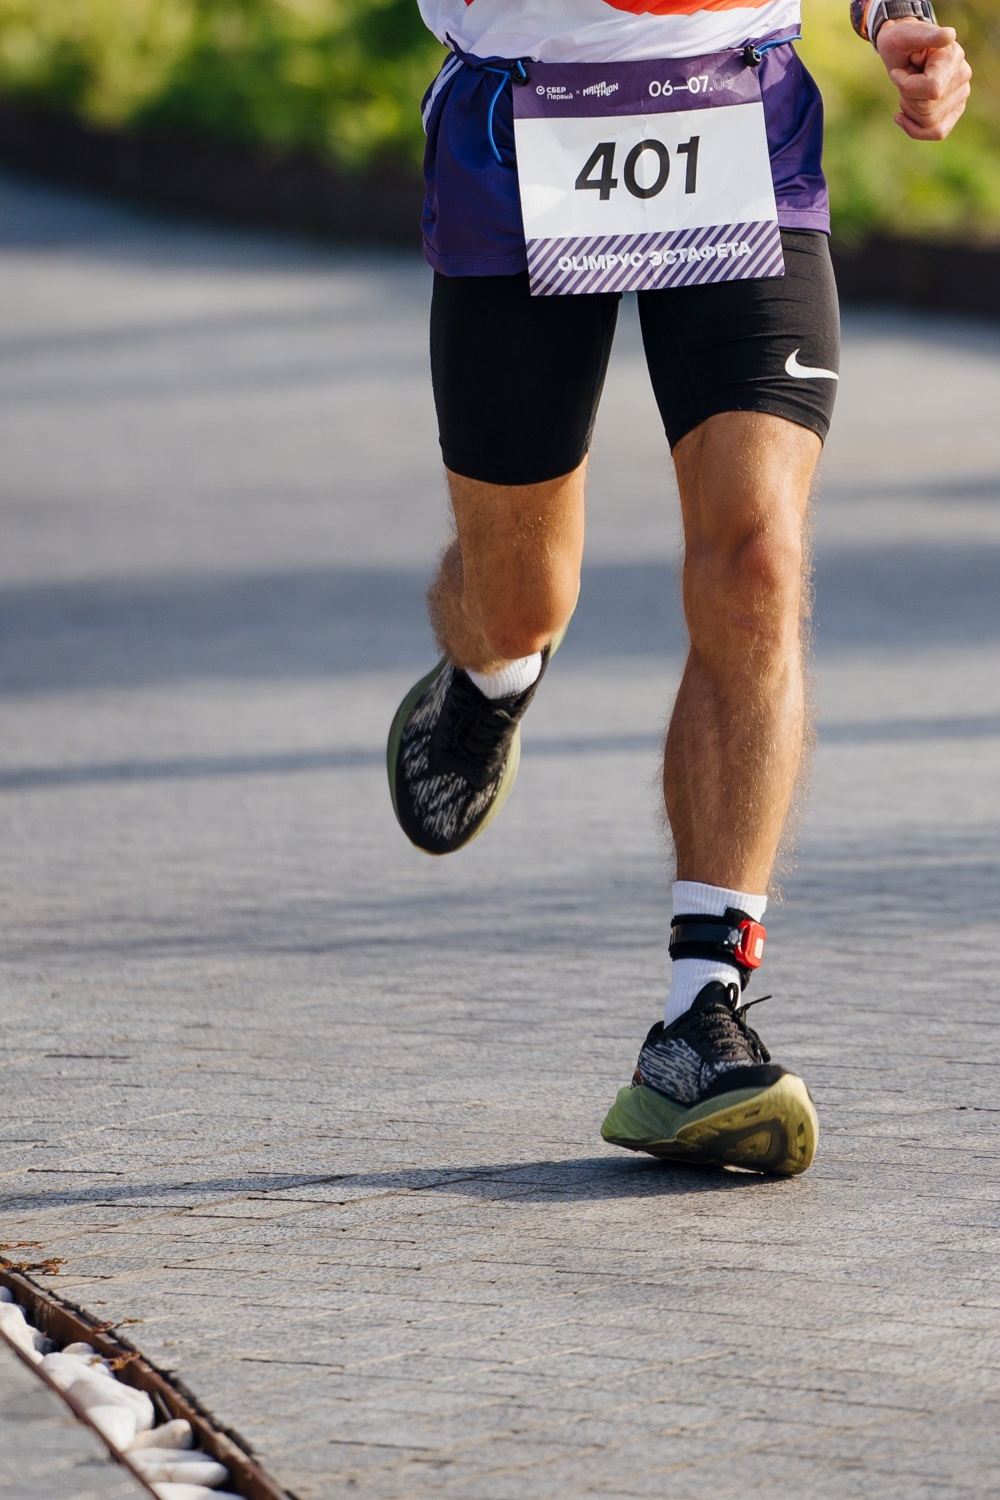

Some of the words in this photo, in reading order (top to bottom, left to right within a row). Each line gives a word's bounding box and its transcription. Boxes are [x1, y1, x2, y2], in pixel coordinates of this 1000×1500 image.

[546, 86, 567, 94] СБЕР
[547, 92, 574, 101] Первый
[575, 135, 700, 201] 401
[649, 241, 753, 268] ЭСТАФЕТА
